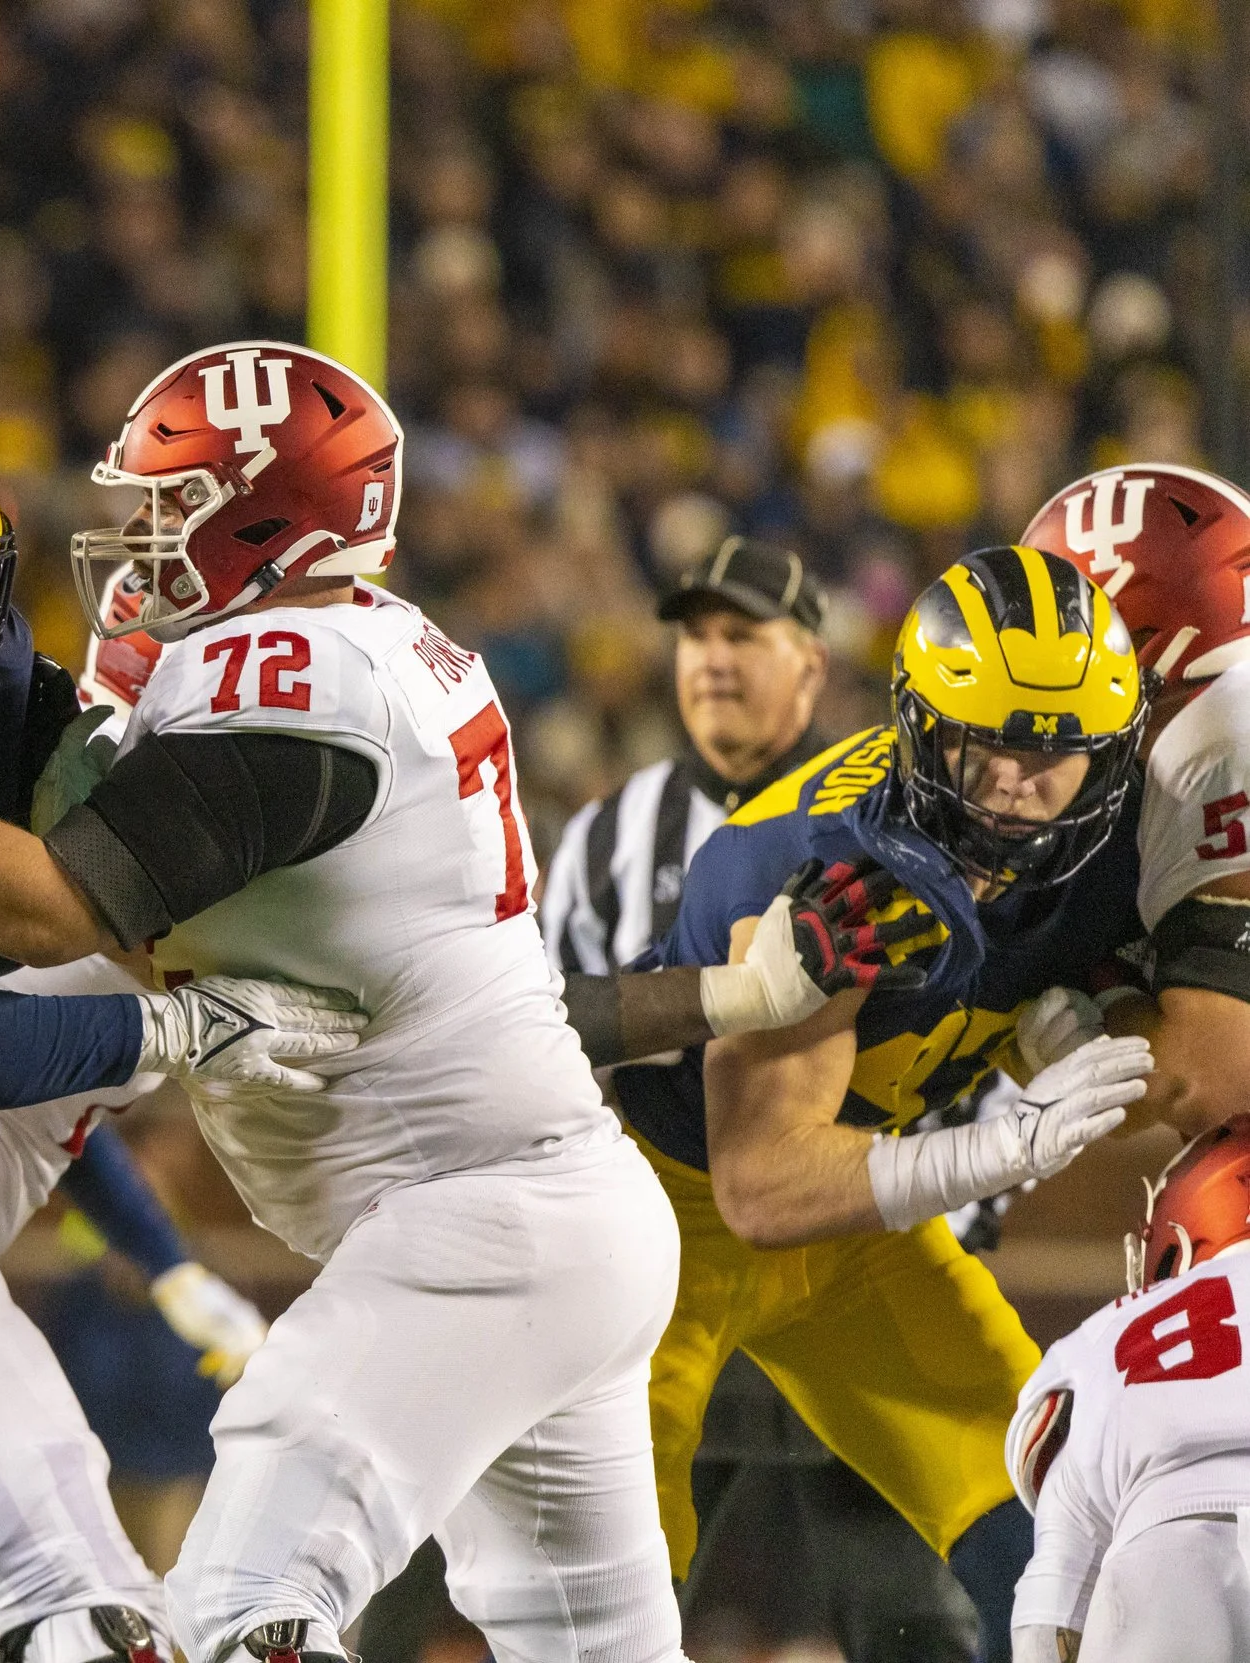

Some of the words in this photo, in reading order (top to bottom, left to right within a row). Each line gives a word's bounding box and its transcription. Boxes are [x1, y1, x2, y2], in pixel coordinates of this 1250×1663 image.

[203, 630, 311, 713] 72
[1032, 714, 1059, 735] M
[448, 699, 530, 923] 7
[1114, 1275, 1243, 1388] 8
